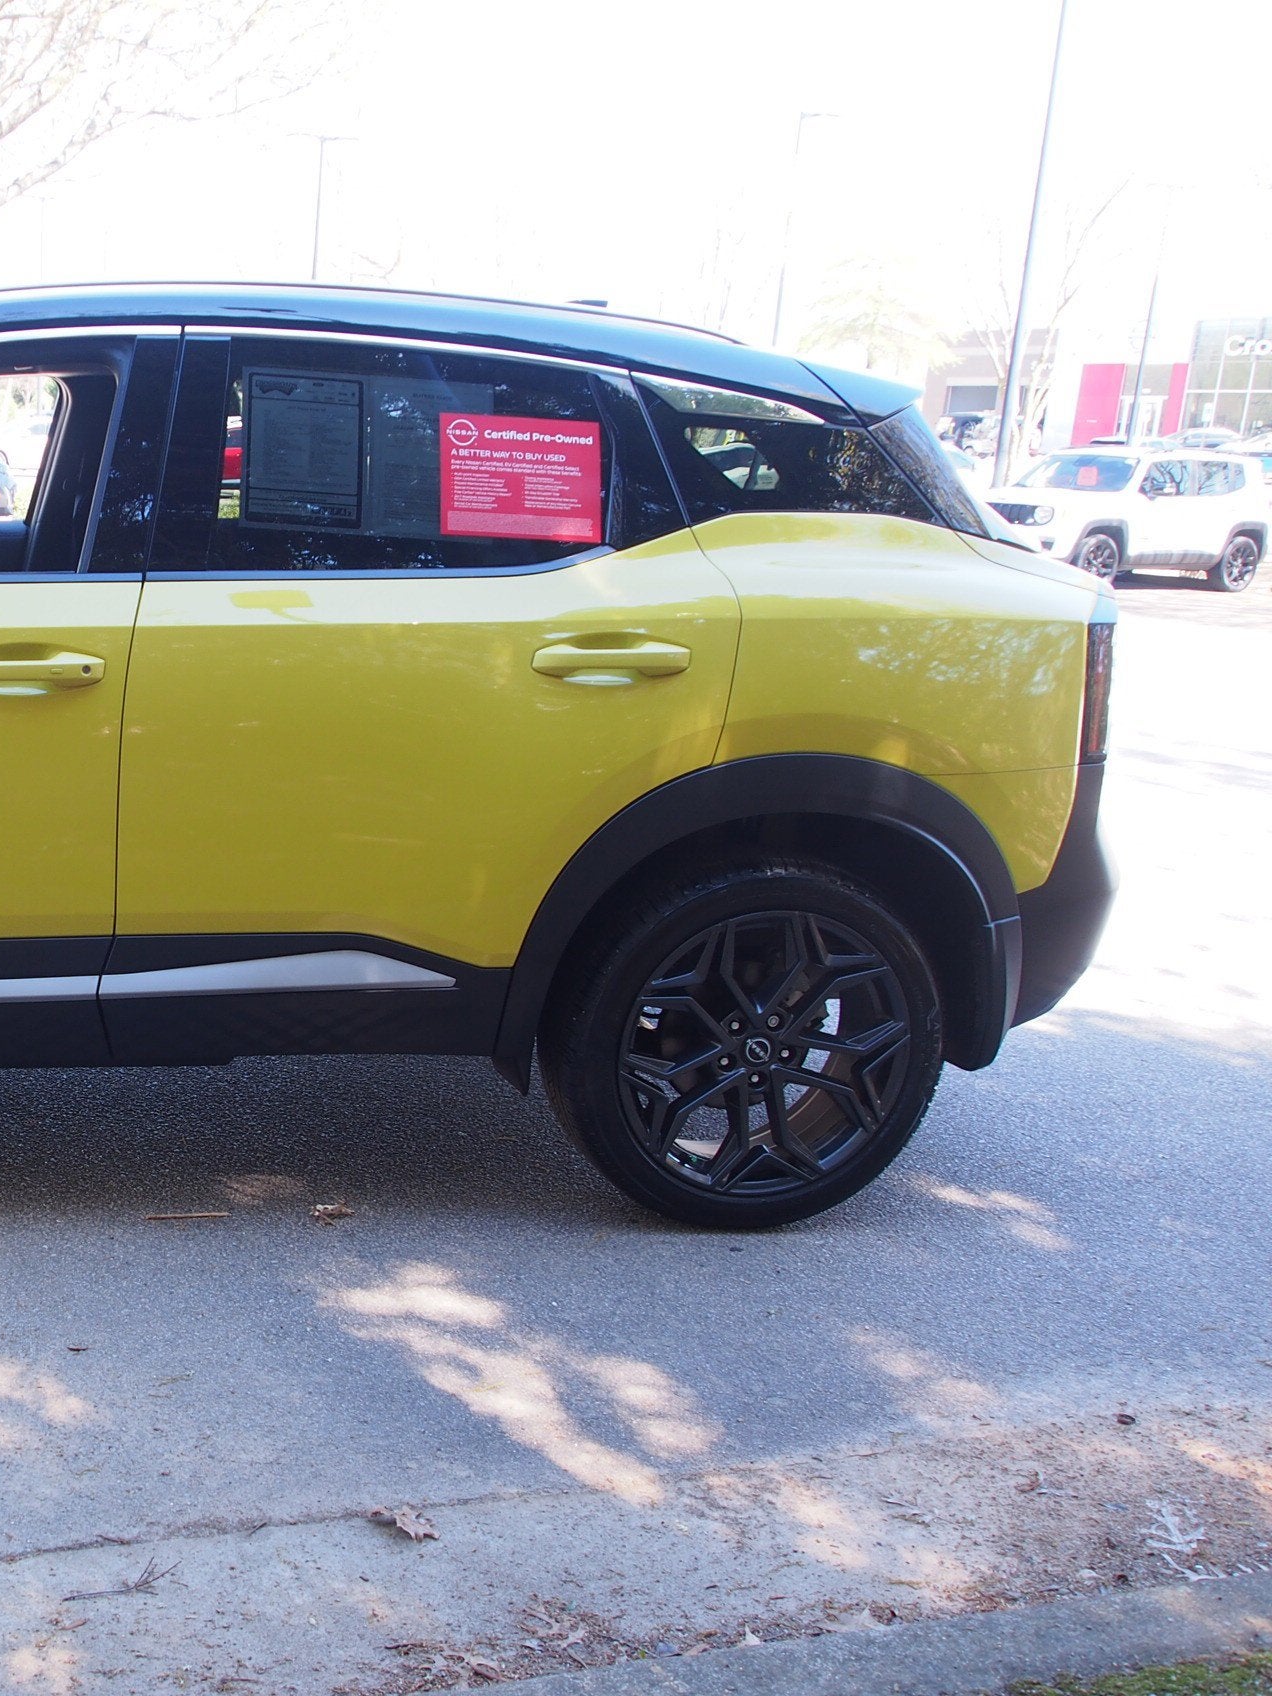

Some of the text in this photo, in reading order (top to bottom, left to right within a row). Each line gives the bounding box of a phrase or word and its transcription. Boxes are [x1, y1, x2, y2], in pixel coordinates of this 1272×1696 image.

[1224, 334, 1272, 357] Cro
[484, 429, 594, 445] Certified Pre-Owned
[451, 448, 566, 461] A BETTER WAY TO BUY USED
